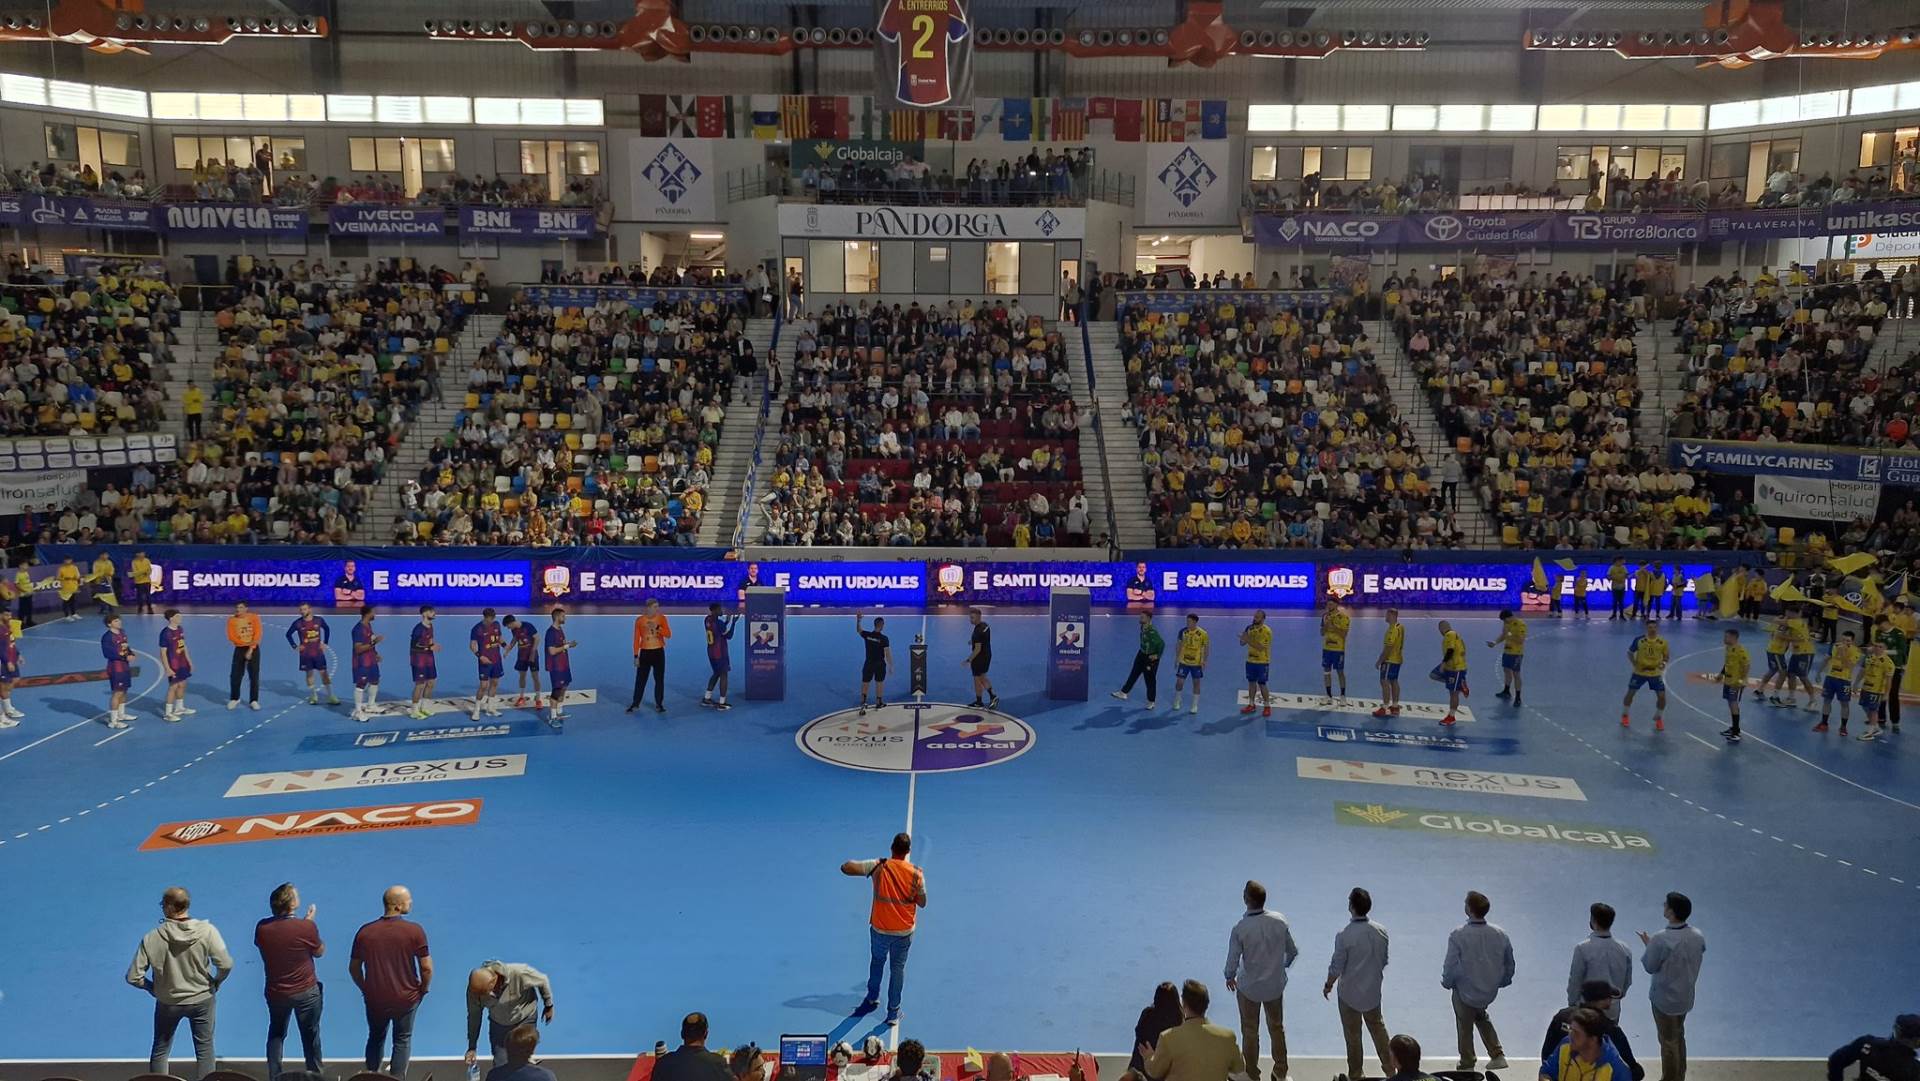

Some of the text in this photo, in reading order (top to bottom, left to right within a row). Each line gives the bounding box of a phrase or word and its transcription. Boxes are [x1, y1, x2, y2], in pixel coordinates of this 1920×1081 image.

[912, 14, 935, 58] 2
[836, 147, 904, 164] Globalcaja
[167, 206, 273, 229] NUNVELA
[358, 210, 415, 220] IVECO
[855, 207, 1009, 237] PANDORGA
[1465, 216, 1507, 229] Toyota
[1603, 216, 1637, 225] GRUPO
[335, 222, 440, 233] VEIMANCHA
[1303, 221, 1379, 236] NACO
[1603, 225, 1698, 239] TorreBlanca
[1731, 218, 1816, 230] TALAVERANA
[1465, 229, 1538, 240] Ciudad Real
[1705, 451, 1834, 472] FAMILYCARNES
[1831, 482, 1877, 494] Hospital
[172, 570, 321, 590] E SANTI URDIALES
[373, 570, 523, 590] E SANTI URDIALES
[580, 572, 724, 591] E SANTI URDIALES
[798, 575, 842, 589] SANTI
[845, 575, 919, 589] URDIALES
[973, 570, 1113, 590] E SANTI URDIALES
[1163, 571, 1308, 590] E SANTI URDIALES
[1363, 574, 1507, 593] E SANTI URDIALES
[1585, 578, 1628, 592] SANI
[407, 724, 511, 738] LOTERÍAS
[817, 735, 904, 743] nexus
[926, 741, 1016, 750] asobal
[361, 758, 509, 778] nexus
[1413, 768, 1562, 790] nexus
[236, 802, 475, 834] NACO
[275, 819, 433, 836] CONSTRUCCIONES
[1418, 814, 1653, 850] Globalcaja
